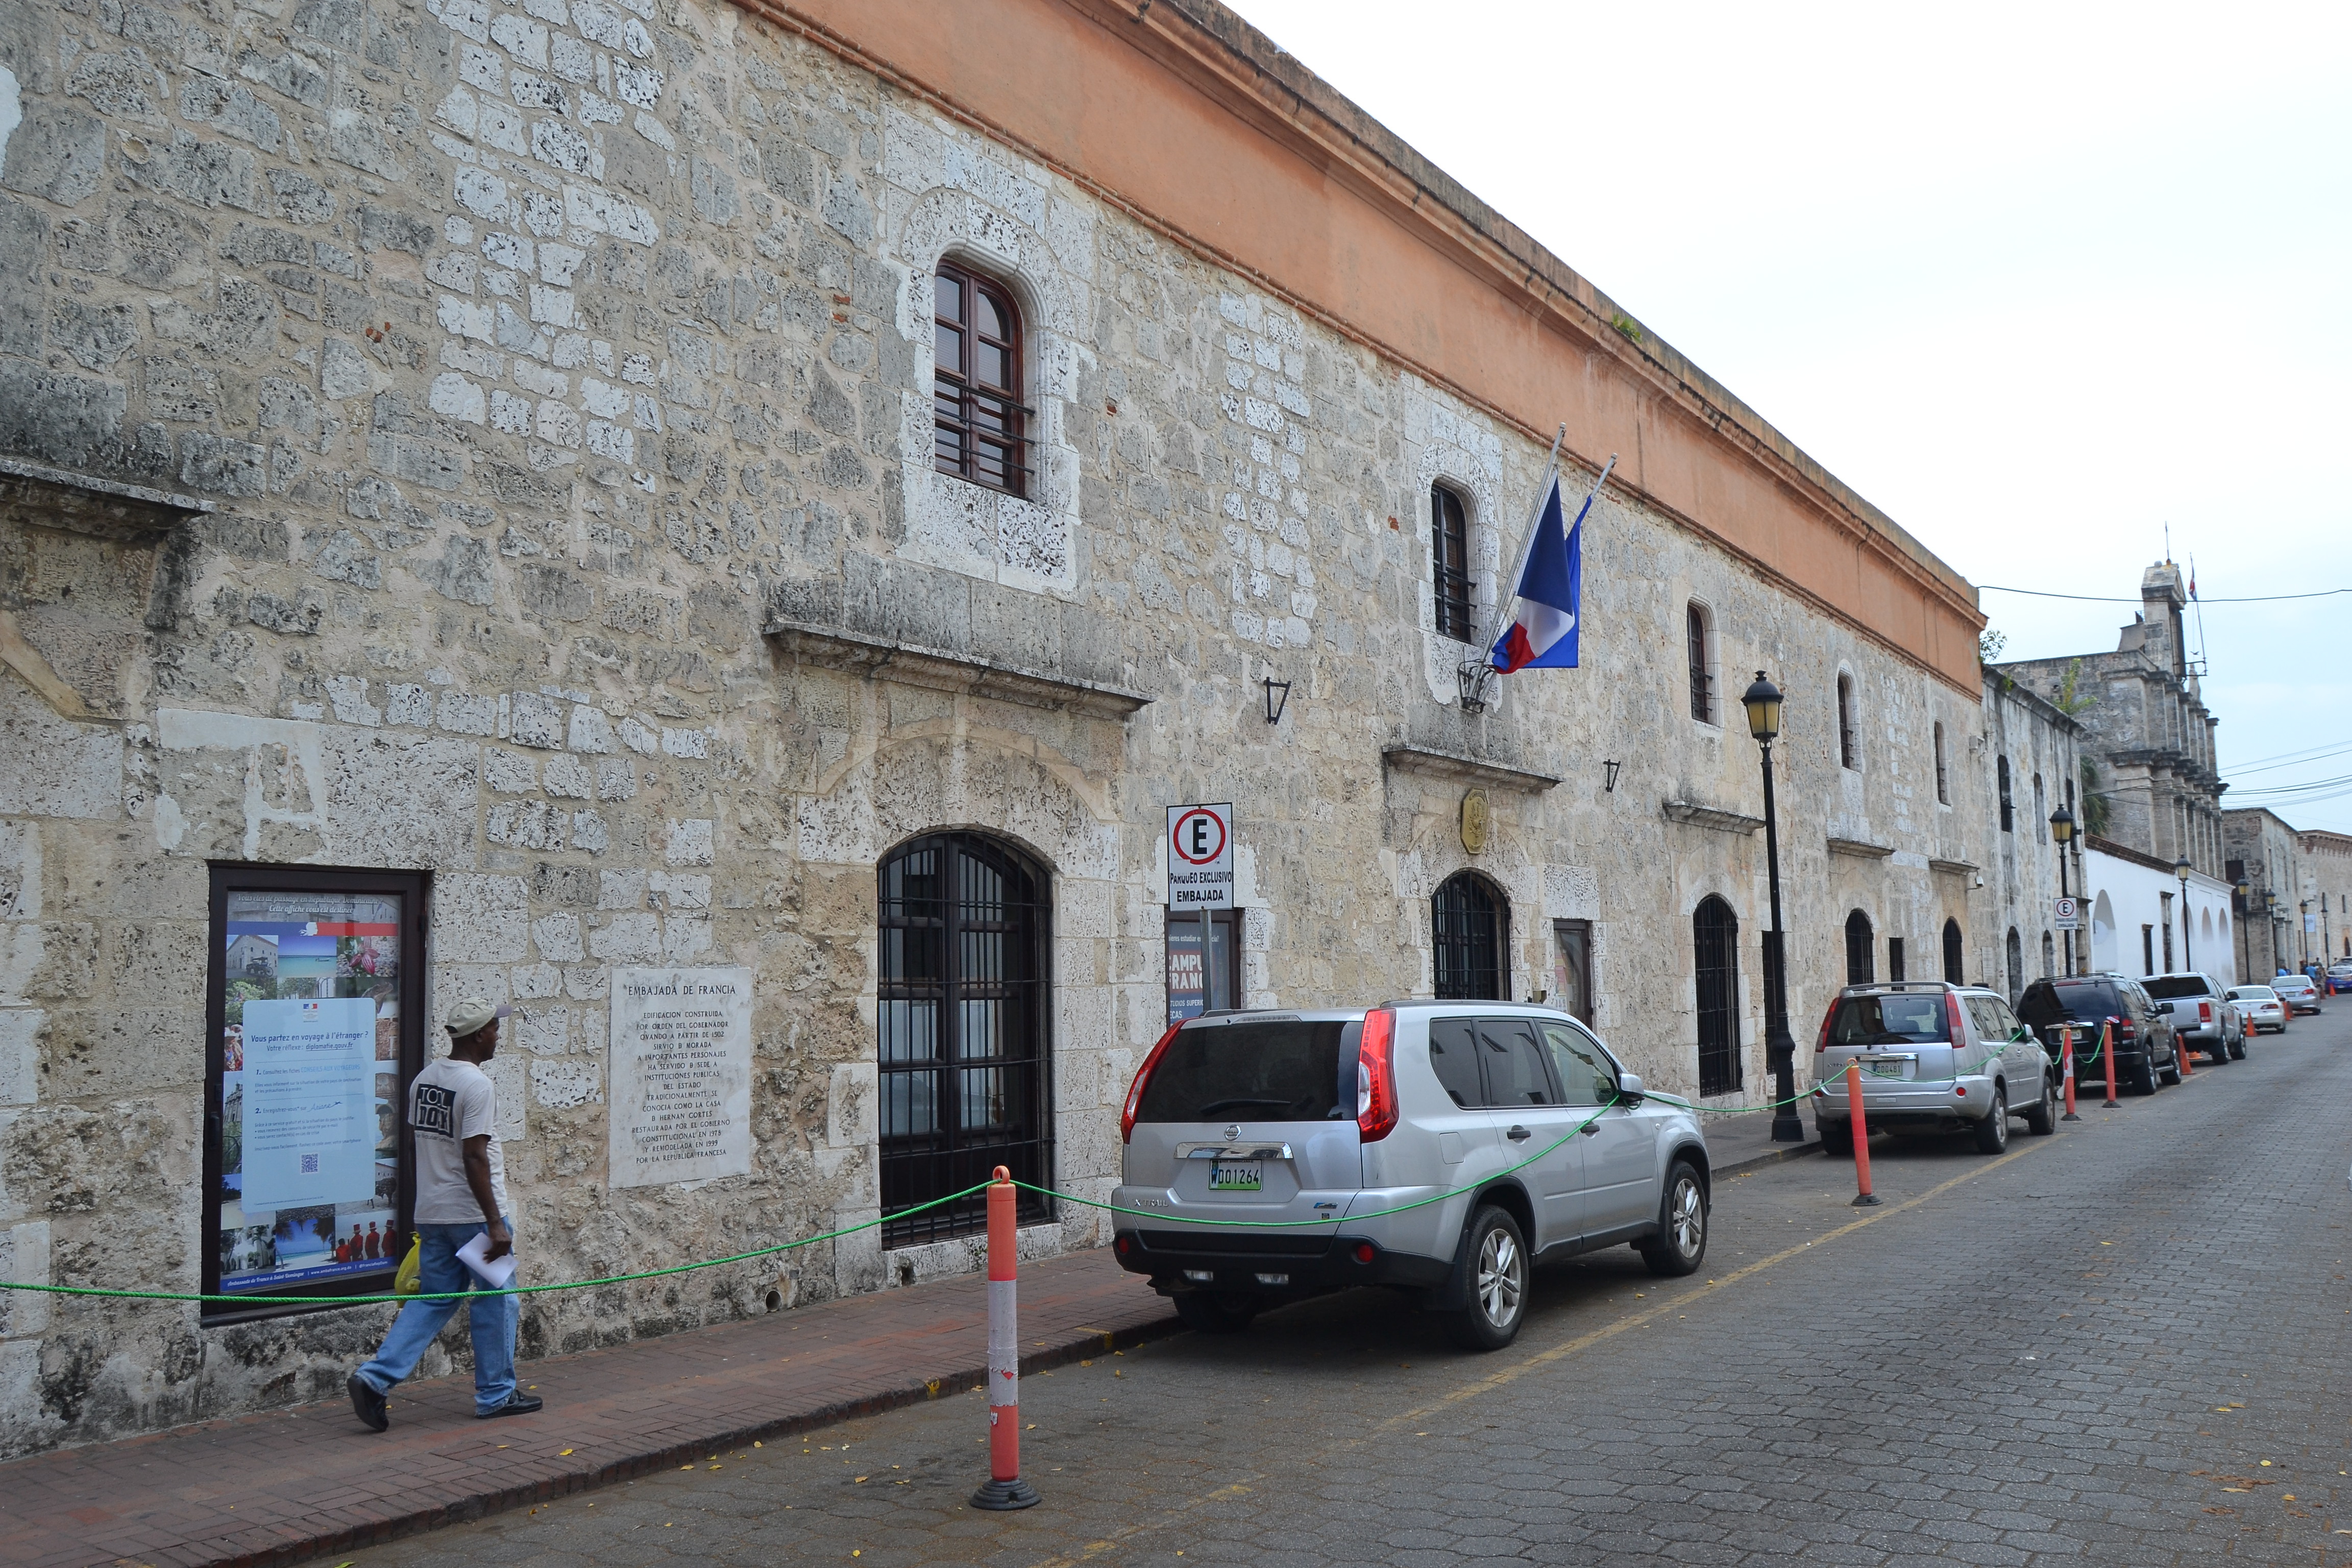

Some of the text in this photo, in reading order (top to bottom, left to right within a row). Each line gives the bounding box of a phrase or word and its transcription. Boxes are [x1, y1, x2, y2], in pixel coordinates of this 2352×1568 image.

[1193, 819, 1207, 854] E
[1170, 871, 1232, 884] PARQUEO EXCLUSIVO
[344, 896, 378, 904] Dominicaine
[1177, 890, 1223, 902] EMBAJADA
[285, 905, 305, 914] affiche
[330, 905, 353, 914] destinée
[2063, 902, 2068, 913] E
[1169, 954, 1202, 971] AMPU
[1169, 973, 1203, 989] RANC
[628, 986, 736, 995] EMBAJADA DE FRANCIA
[268, 1034, 289, 1043] partez
[301, 1034, 324, 1042] voyage
[306, 1042, 353, 1050] diplomatie.gouv.fr
[645, 1072, 690, 1081] INSTITUCIONES
[421, 1087, 447, 1108] TOOL
[647, 1091, 707, 1100] TRADICIONALMENTE
[632, 1125, 672, 1134] RESTAURADA
[700, 1119, 730, 1128] GOBIERNO
[642, 1133, 695, 1143] CONSTITUCIONAL
[653, 1143, 692, 1152] REMODELADA
[697, 1149, 726, 1158] FRANCESA
